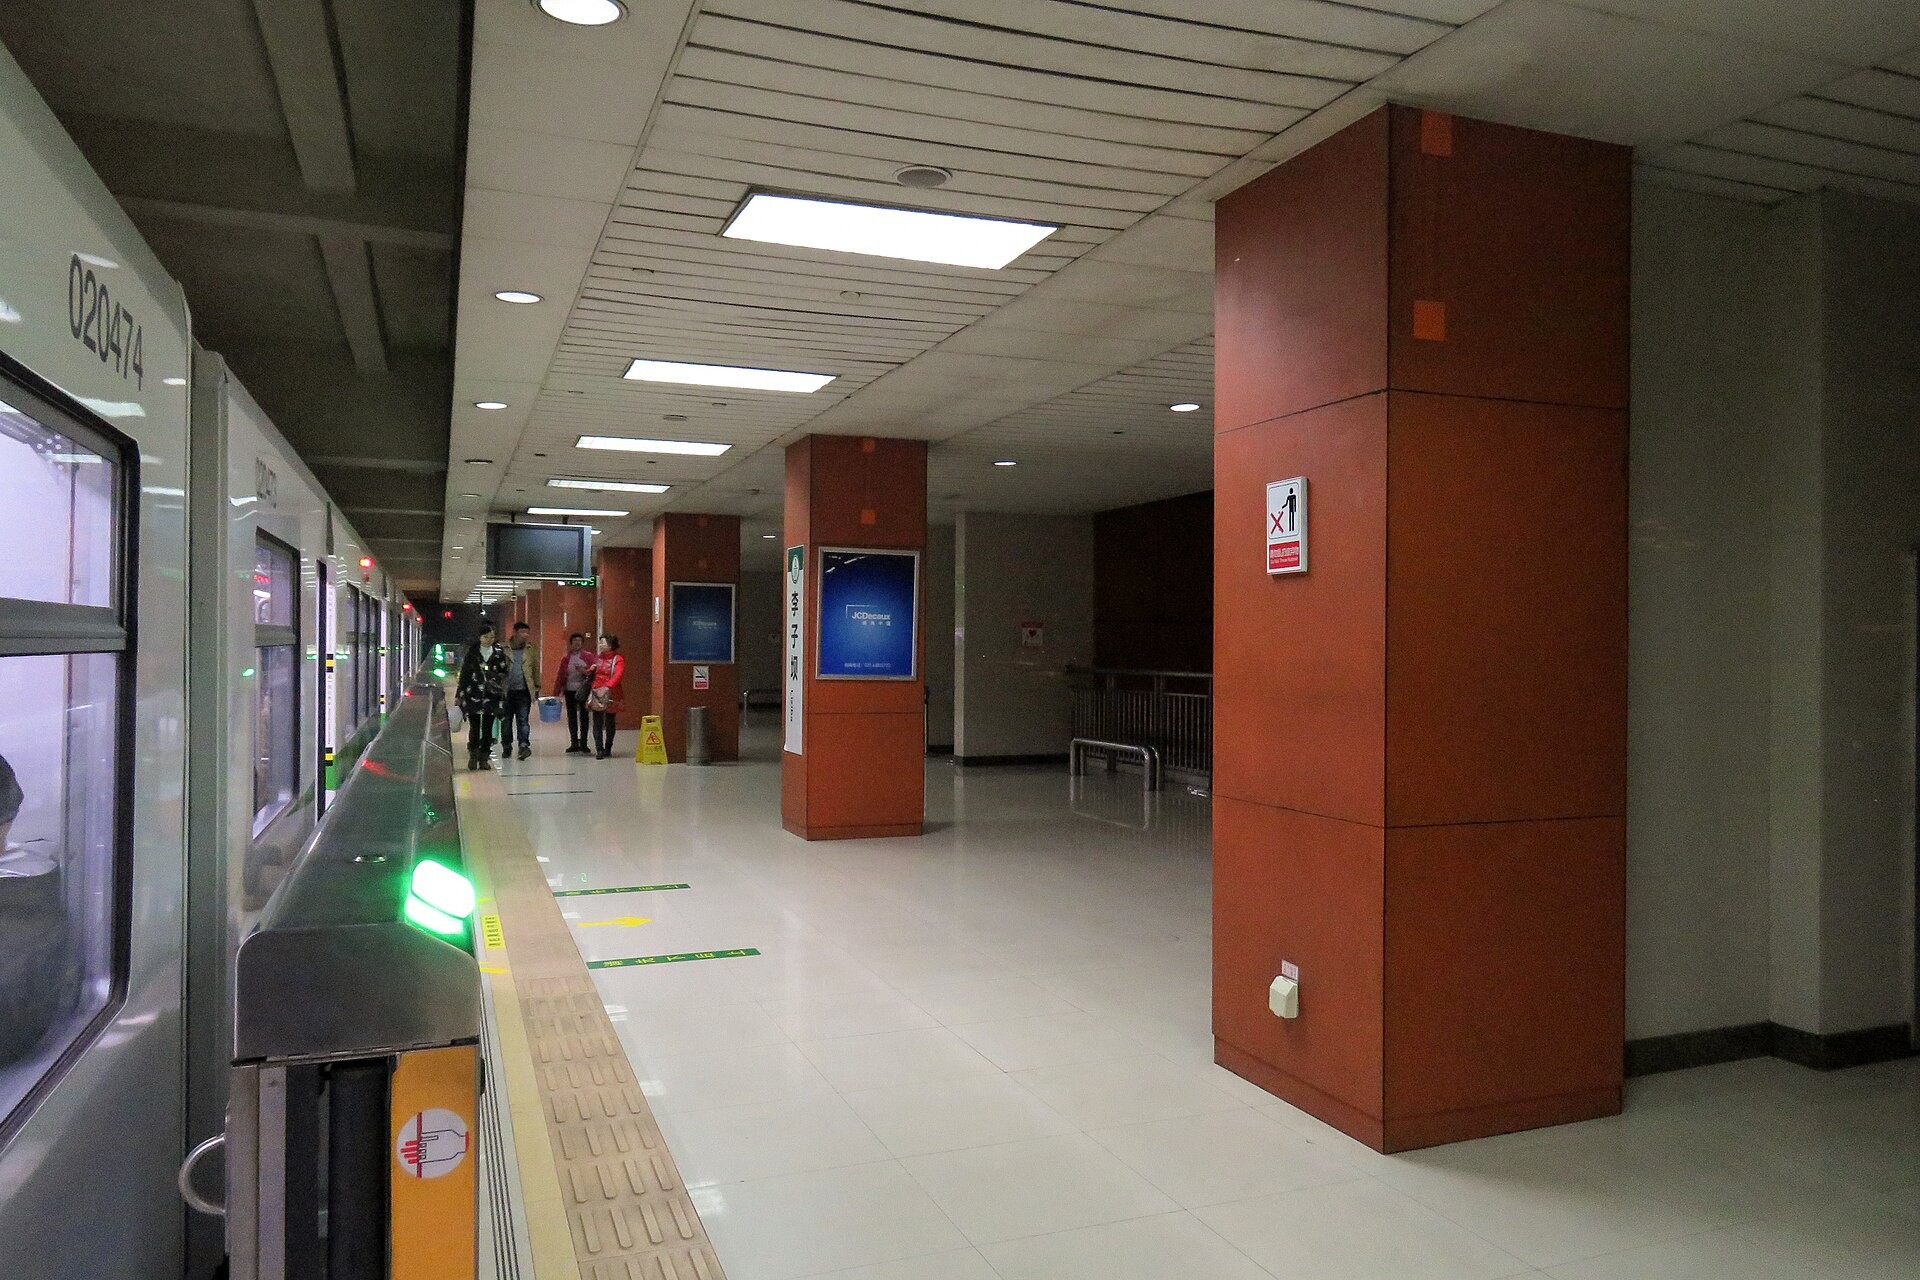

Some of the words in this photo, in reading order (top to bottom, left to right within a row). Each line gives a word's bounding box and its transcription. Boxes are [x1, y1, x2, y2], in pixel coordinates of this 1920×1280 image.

[69, 253, 144, 392] 020474
[790, 590, 799, 681] 李子坝
[851, 611, 891, 620] JCDecaux
